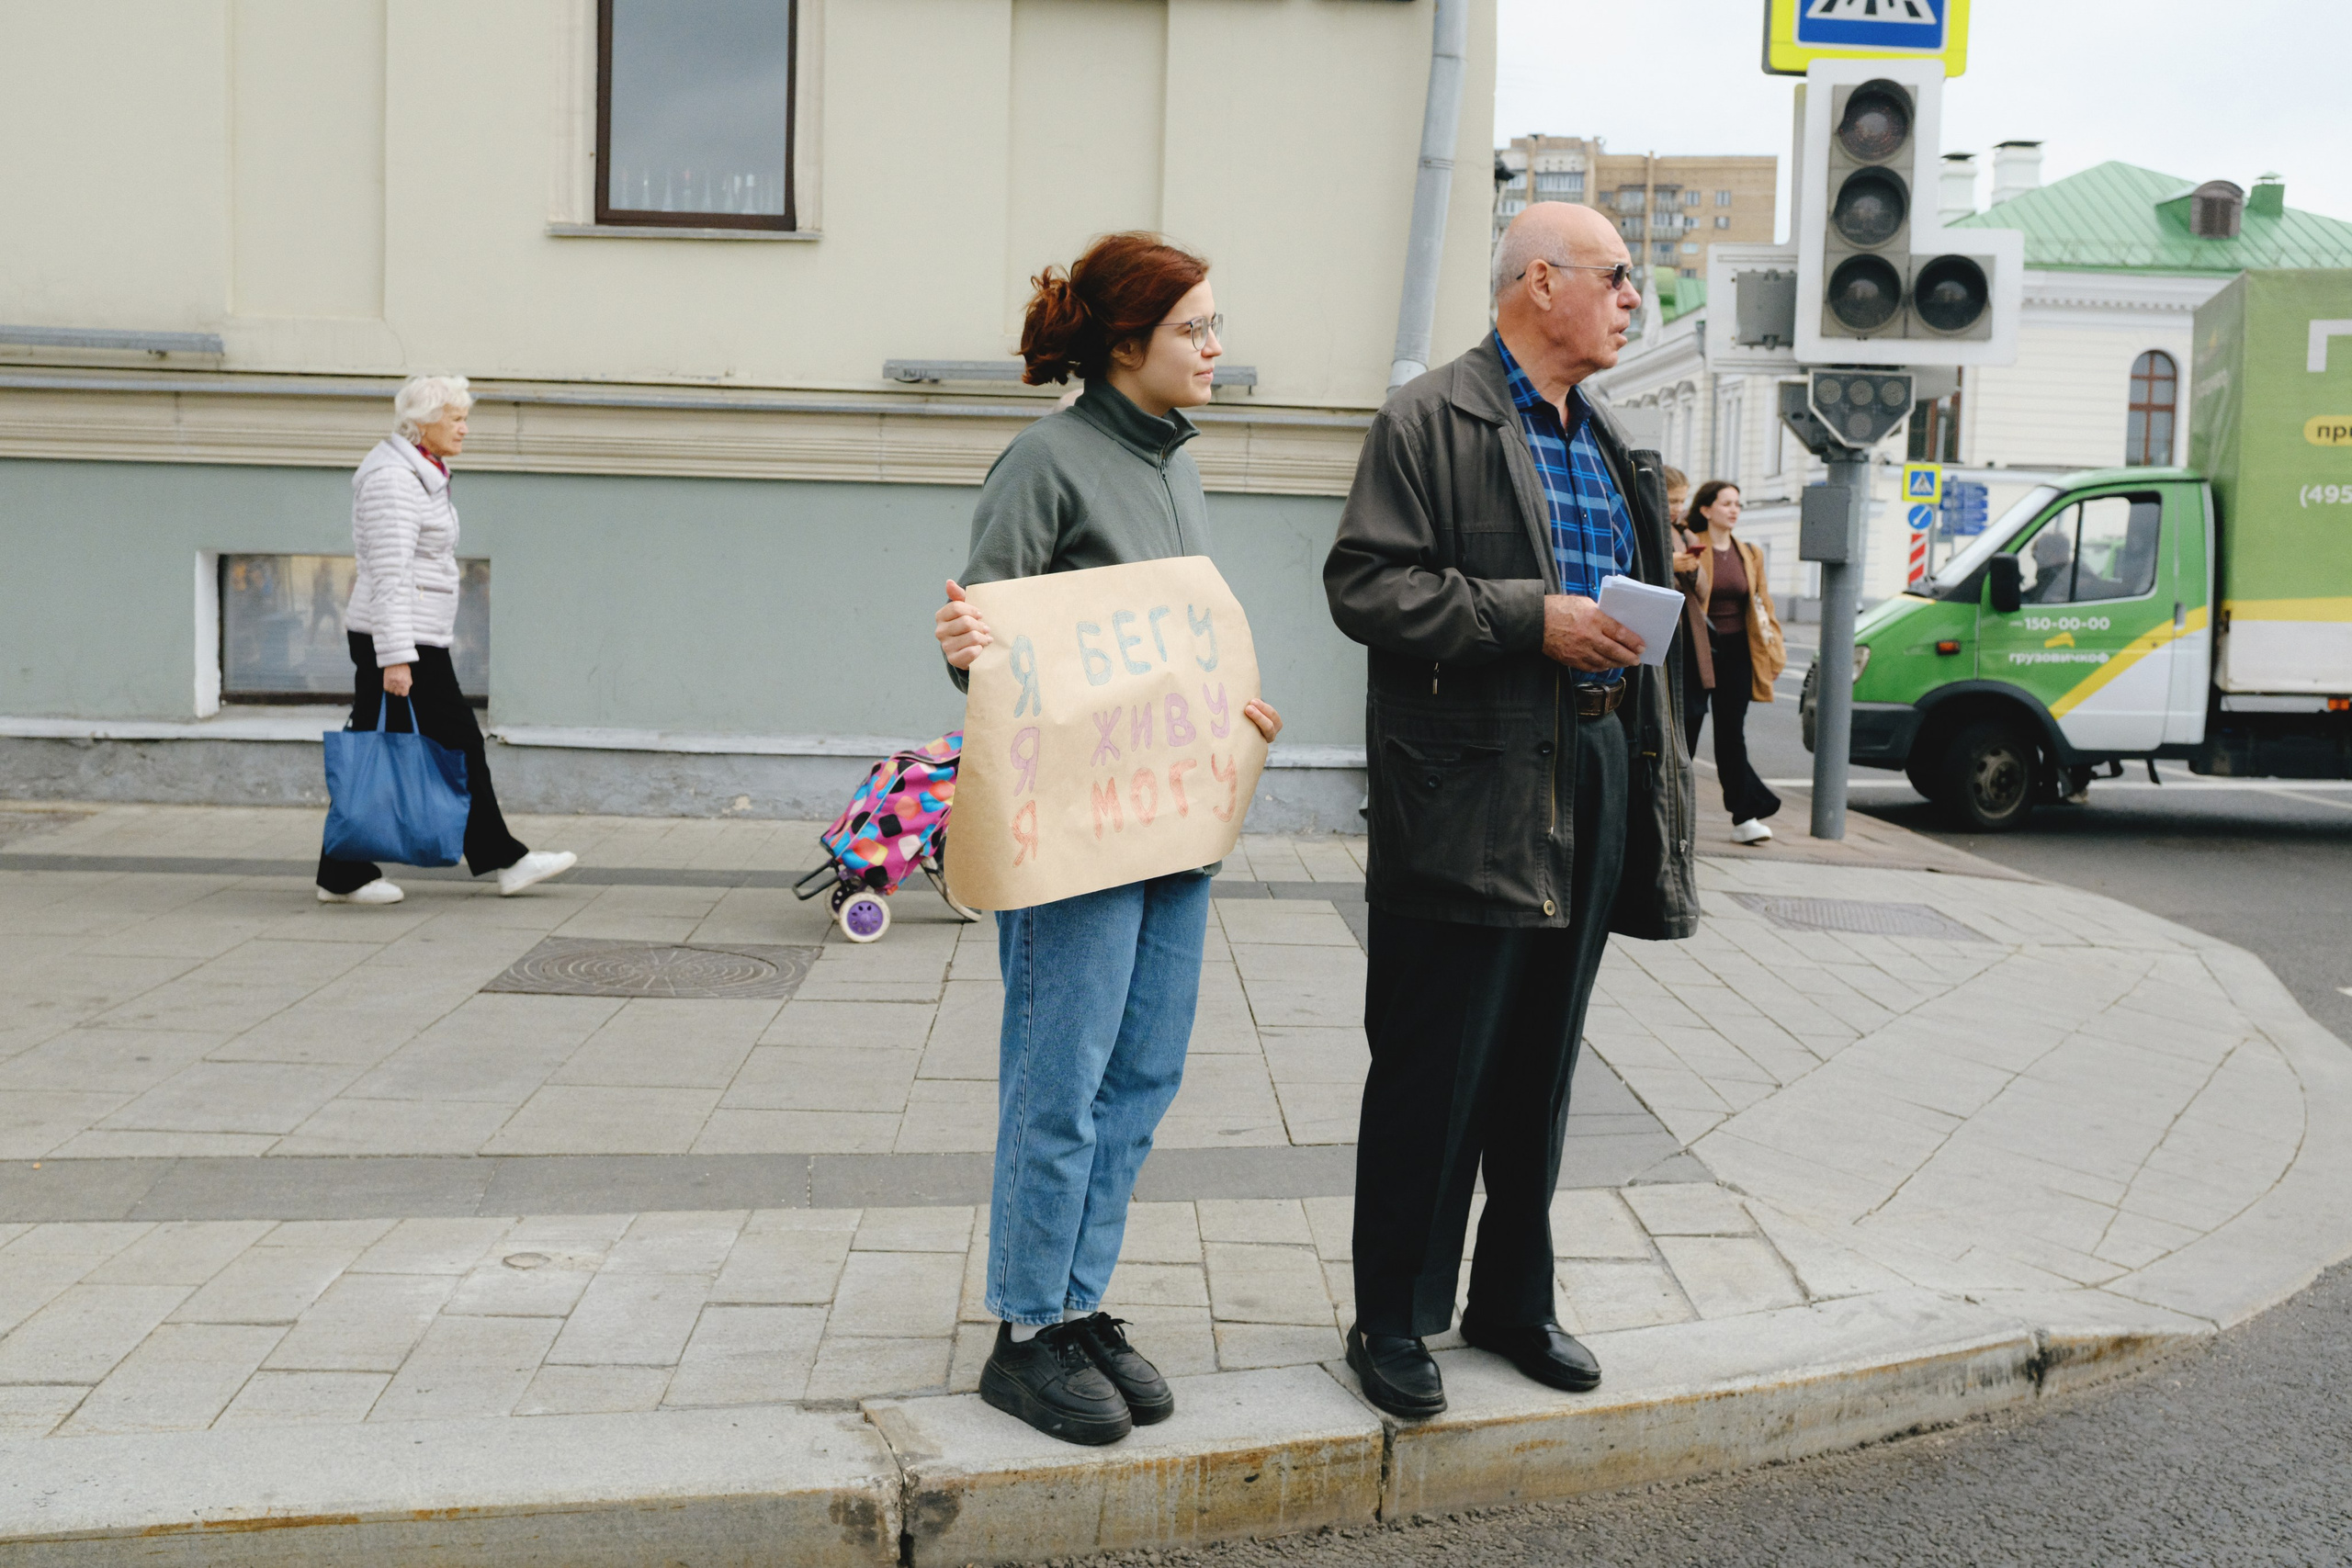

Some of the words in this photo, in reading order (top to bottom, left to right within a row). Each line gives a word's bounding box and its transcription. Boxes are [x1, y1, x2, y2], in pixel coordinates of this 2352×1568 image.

[2317, 425, 2352, 442] пр
[1011, 635, 1042, 718] Я
[1077, 604, 1219, 686] БЕГУ
[2024, 616, 2111, 630] 150-00-00
[1012, 727, 1040, 796] Я
[1091, 682, 1230, 767] ЖИВУ
[1012, 799, 1038, 868] Я
[1091, 753, 1237, 840] МОГУ
